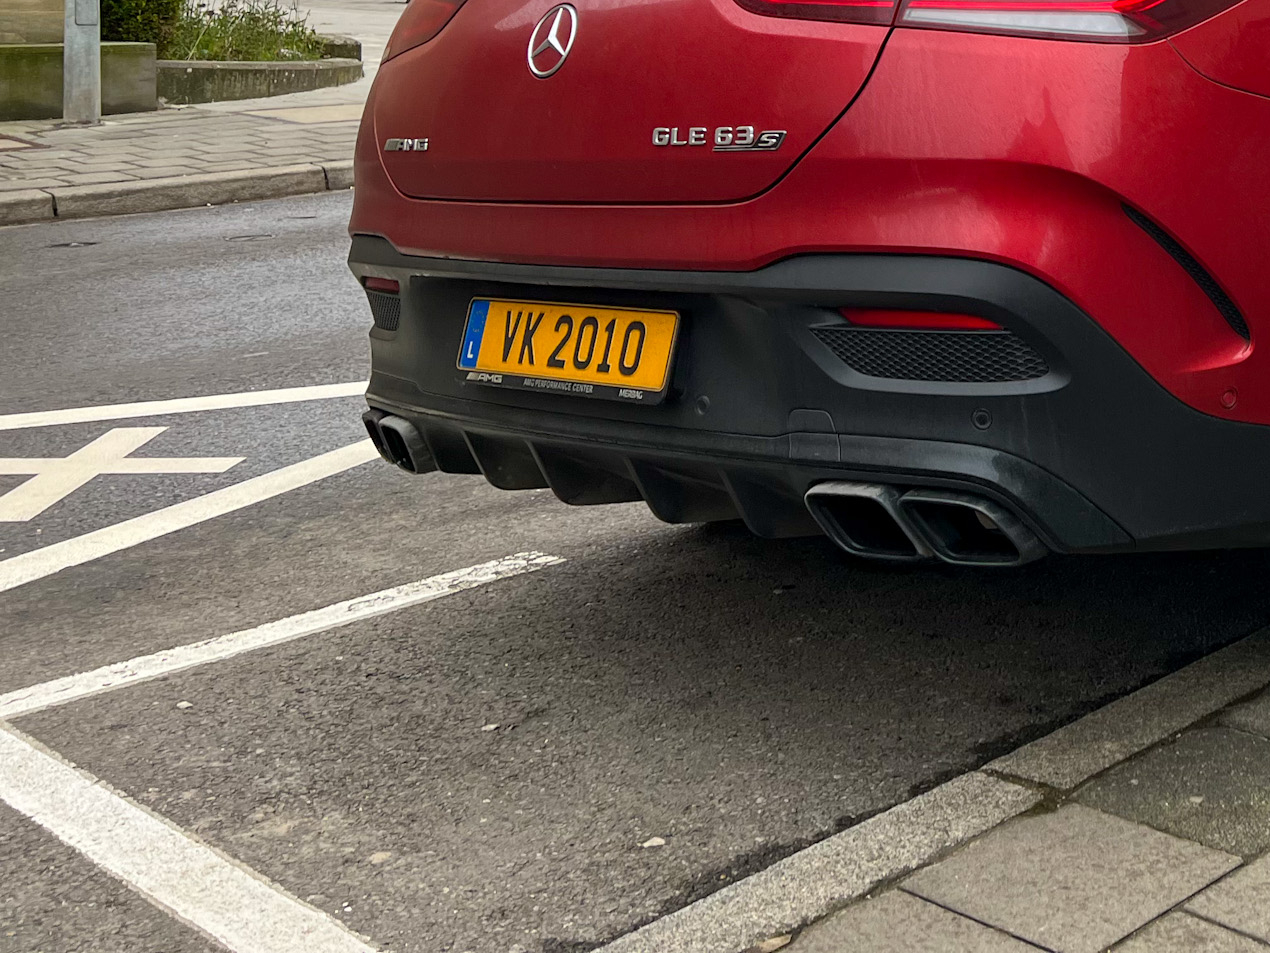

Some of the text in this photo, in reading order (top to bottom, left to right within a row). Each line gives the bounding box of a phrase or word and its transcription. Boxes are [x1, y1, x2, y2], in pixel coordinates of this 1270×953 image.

[396, 138, 429, 151] AMG
[652, 127, 706, 147] GLE
[466, 309, 648, 376] L VK 2010
[477, 373, 503, 384] AMG
[523, 378, 594, 394] AMG PERFORMANCE CENTER
